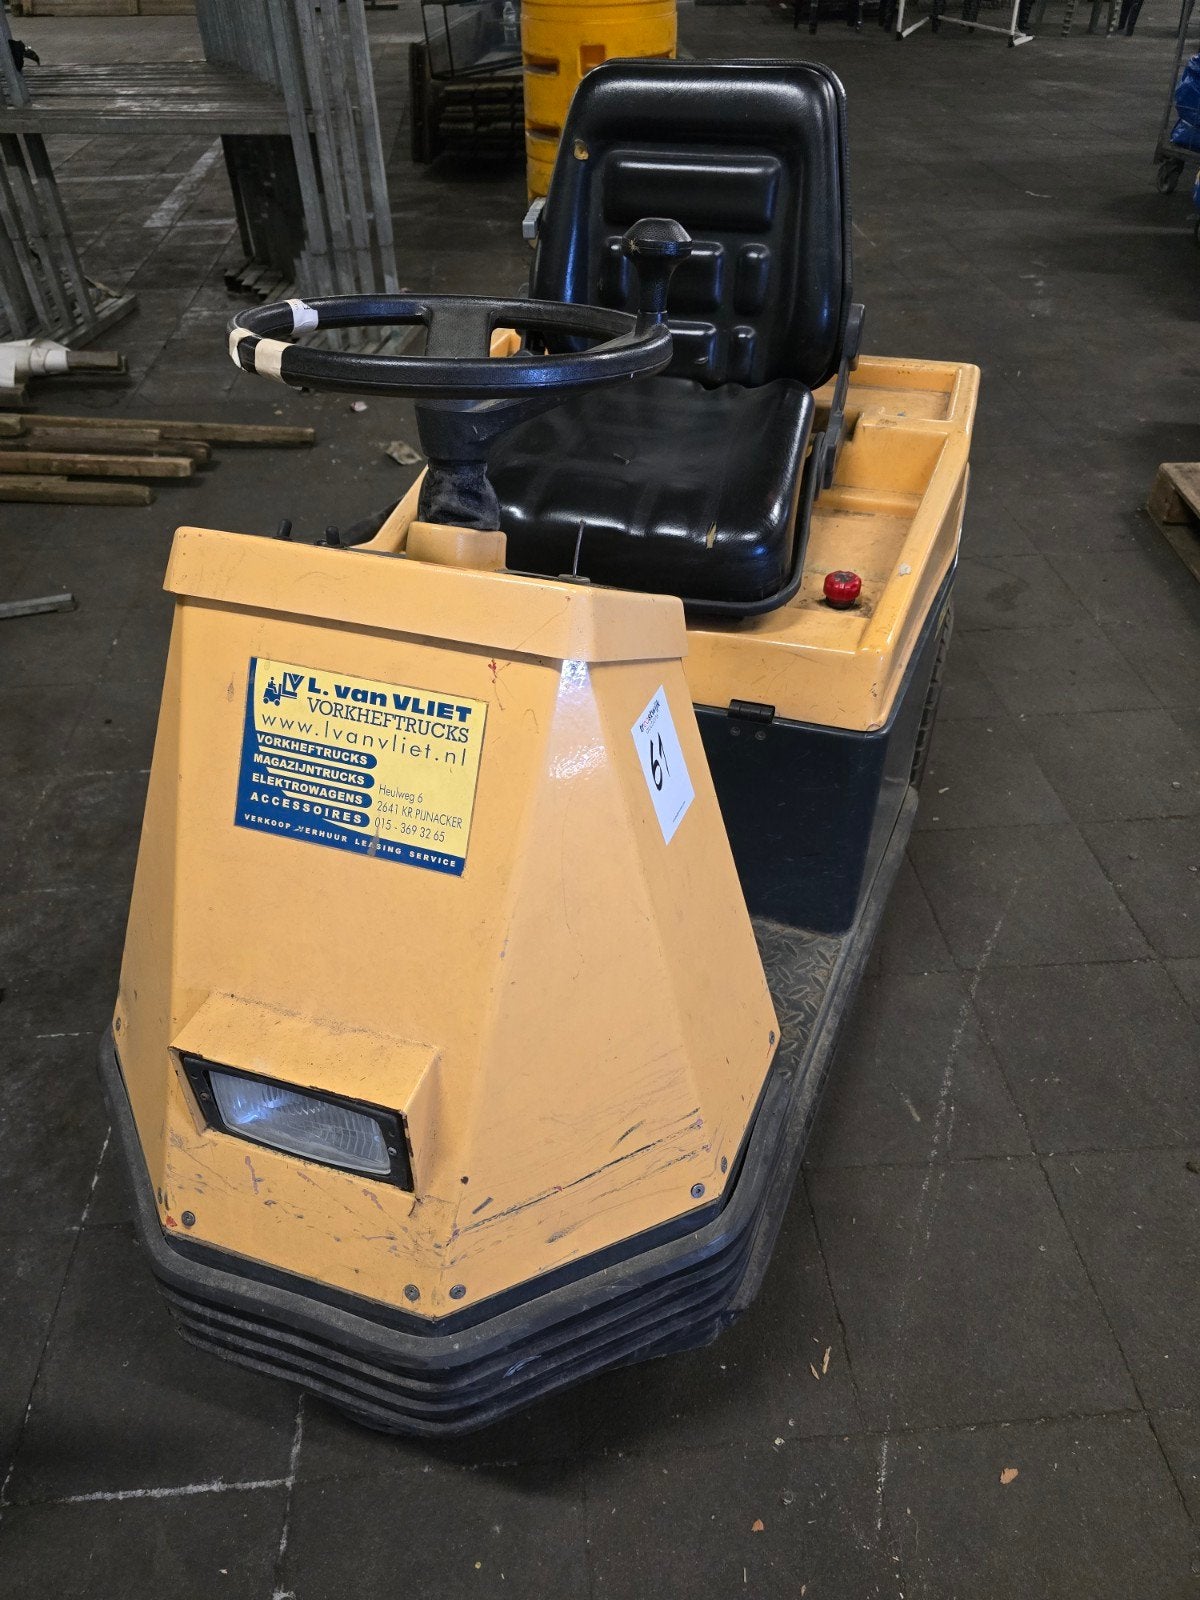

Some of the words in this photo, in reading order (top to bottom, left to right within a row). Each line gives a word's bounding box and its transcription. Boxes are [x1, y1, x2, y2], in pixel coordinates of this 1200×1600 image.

[308, 677, 329, 695] L.
[334, 684, 387, 707] van
[393, 693, 472, 722] VLIET
[307, 697, 469, 743] VORKHEFTRUCKS
[256, 733, 368, 765] VORKHEFTRUCKS
[262, 714, 466, 766] www.lvanvliet.nl
[253, 753, 365, 785] MAGAZIJNTRUCKS
[650, 732, 670, 791] 61
[252, 773, 363, 805] ELEKTROWAGENS
[379, 784, 415, 804] Heulweg
[417, 793, 424, 804] 6
[250, 792, 362, 824] ACCESSOIRES
[377, 800, 398, 814] 2641
[402, 806, 413, 818] KR
[415, 808, 462, 829] PIJNACKER
[244, 813, 291, 829] VERKOOP
[409, 851, 456, 867] SERVICE
[374, 817, 391, 830] 015
[400, 822, 417, 835] 369
[420, 826, 431, 839] 32
[433, 830, 445, 843] 65
